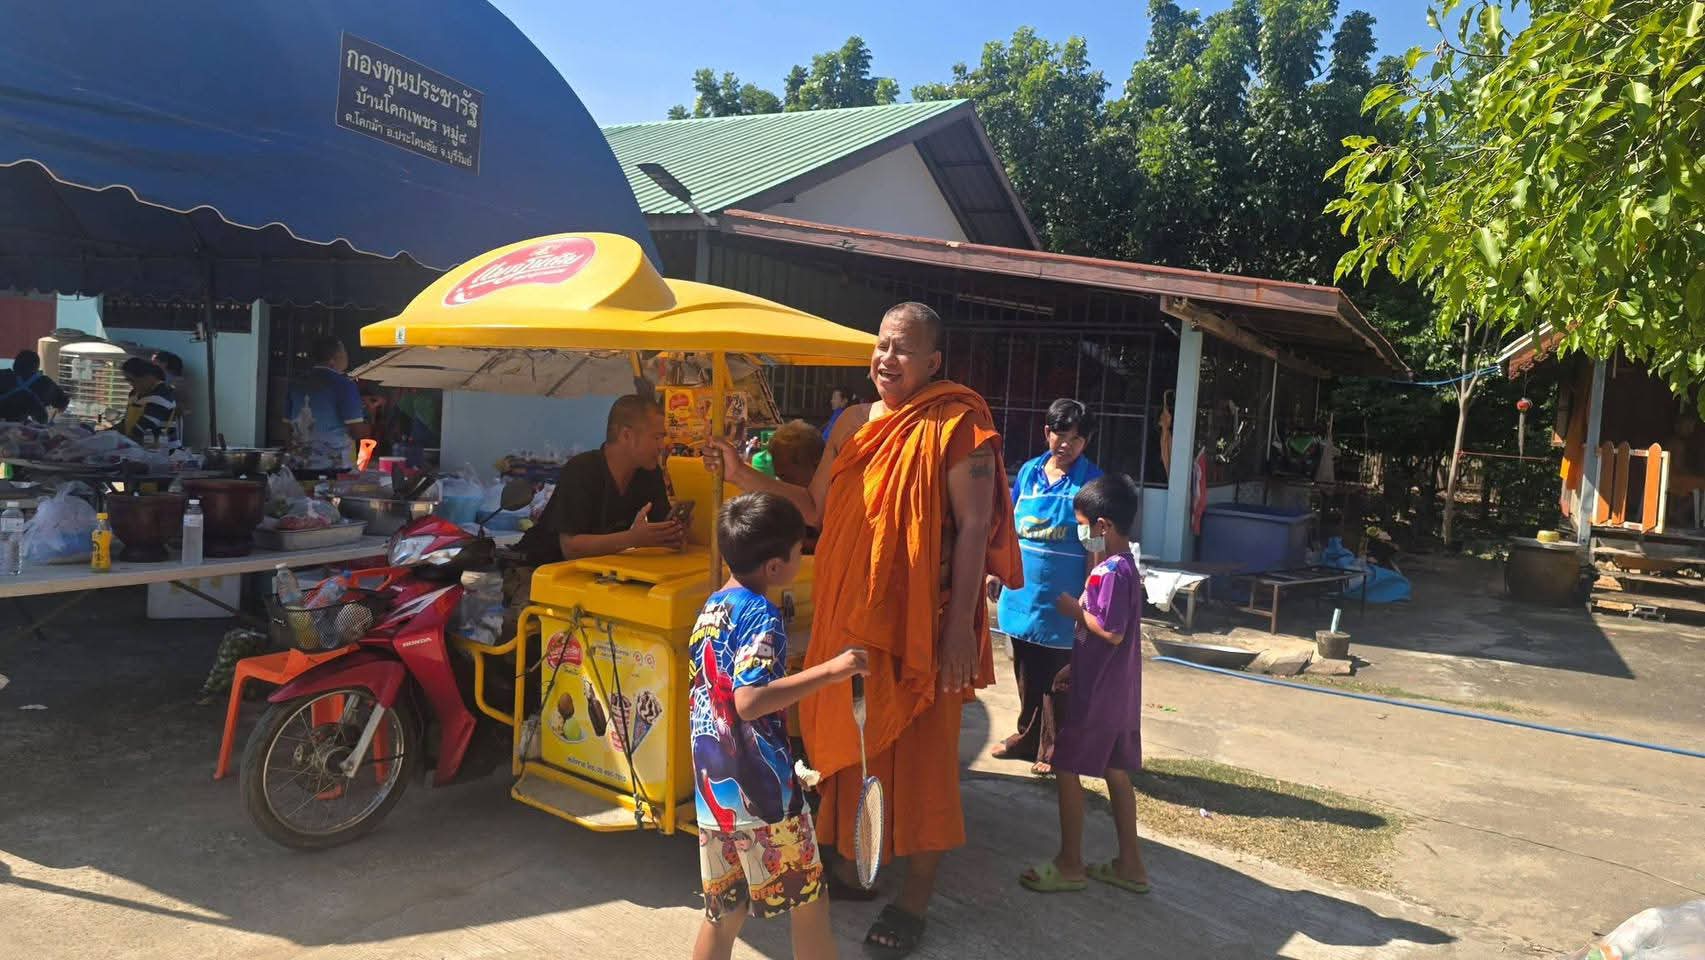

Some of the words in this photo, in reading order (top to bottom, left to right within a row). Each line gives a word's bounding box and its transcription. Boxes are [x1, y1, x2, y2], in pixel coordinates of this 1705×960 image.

[347, 49, 478, 128] กองทุนประชารัฐ
[355, 86, 438, 132] บ้านโคกเพชร
